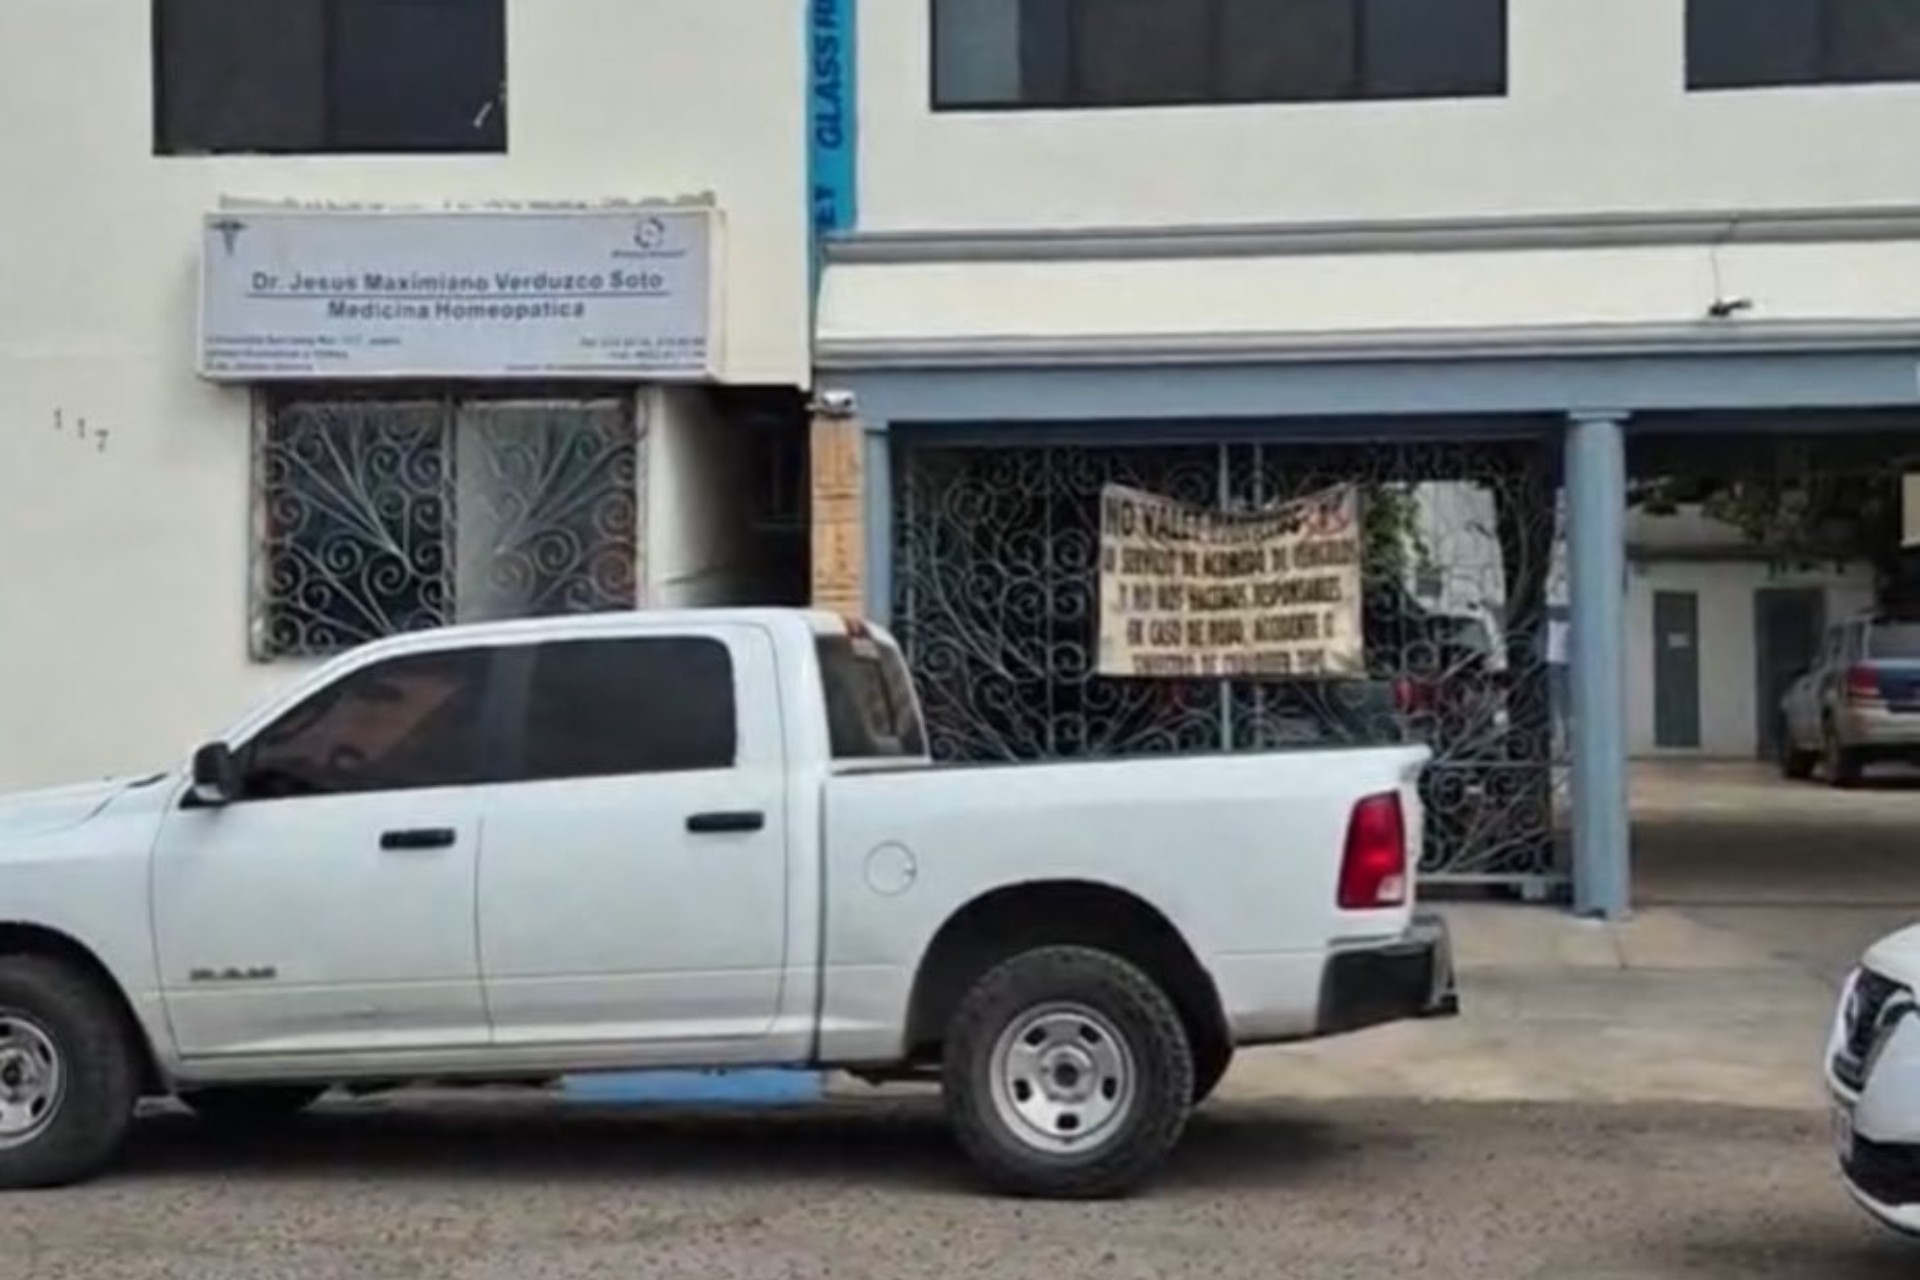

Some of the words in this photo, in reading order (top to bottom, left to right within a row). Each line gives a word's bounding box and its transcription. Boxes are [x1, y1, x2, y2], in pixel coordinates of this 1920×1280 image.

[814, 35, 843, 149] GLASS
[252, 271, 283, 290] Dr.
[289, 273, 358, 290] Jesus
[364, 272, 489, 290] Maximiano
[495, 271, 603, 290] Verduzco
[609, 269, 664, 289] Soto
[328, 300, 429, 318] Medicina
[435, 300, 584, 320] Homeopatica
[1149, 618, 1182, 647] CASO
